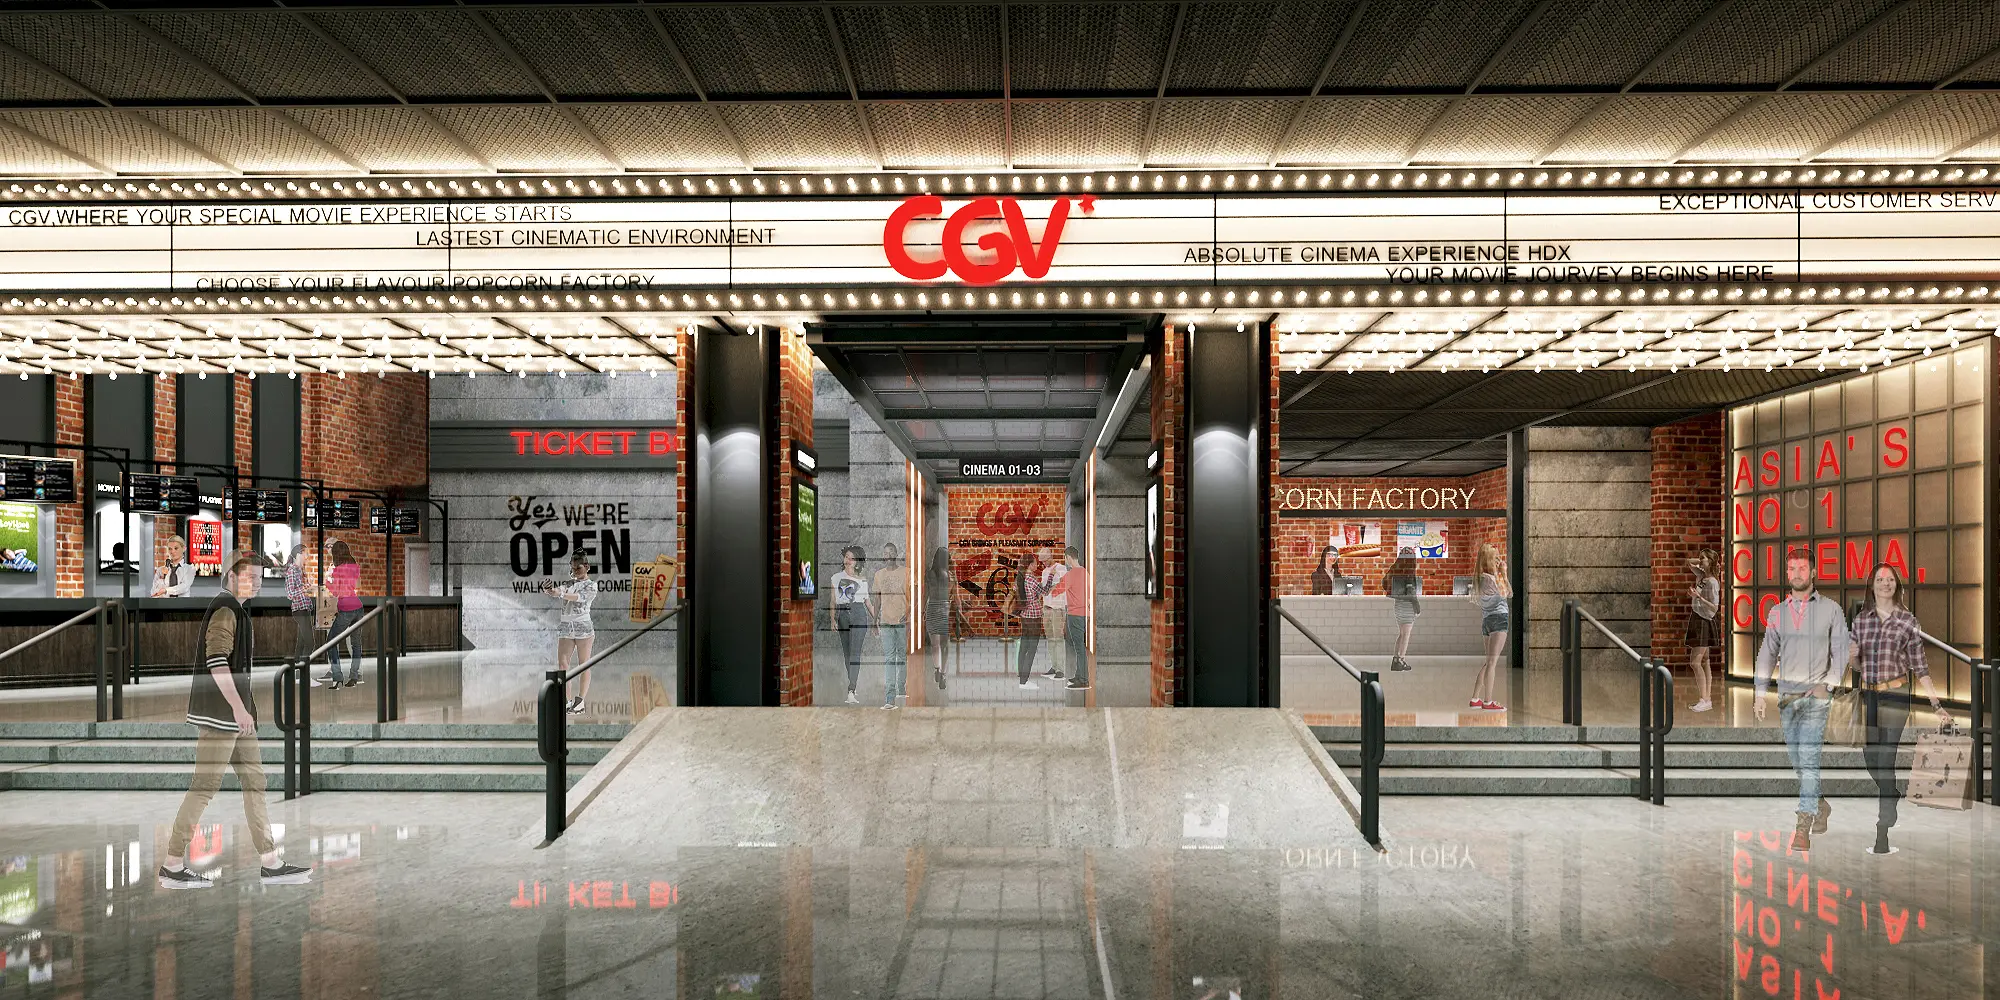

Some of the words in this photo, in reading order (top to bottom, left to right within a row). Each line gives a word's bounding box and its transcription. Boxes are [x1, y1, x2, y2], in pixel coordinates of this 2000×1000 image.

[1660, 192, 1804, 211] EXCEPTIONAL
[1813, 191, 1932, 209] CUSTOMER
[1940, 191, 1997, 208] SERV
[137, 208, 192, 225] YOUR
[200, 207, 283, 225] SPECIAL
[290, 207, 352, 224] MOVIE
[360, 206, 486, 223] EXPERIENCE
[494, 205, 572, 222] STARTS
[416, 229, 503, 246] LASTEST
[511, 228, 621, 246] CINEMATIC
[629, 228, 777, 245] ENVIRONMENT
[884, 195, 1071, 284] CGV
[1183, 246, 1293, 263] ABSOLUTE
[1300, 246, 1380, 262] CINEMA
[1388, 245, 1520, 262] EXPERIENCE
[1528, 244, 1572, 261] HDX
[196, 277, 281, 293] CHOOSE
[289, 277, 345, 293] YOUR
[352, 276, 444, 292] FLAVOUR
[453, 275, 552, 292] POPCORN
[561, 275, 655, 291] FACTORY
[1386, 267, 1445, 284] YOUR
[1452, 266, 1518, 284] MOVIE
[1525, 266, 1624, 283] JOURVEY
[1631, 265, 1709, 282] BEGINS
[1717, 264, 1774, 282] HERE
[510, 431, 637, 456] TICKET
[649, 431, 678, 456] B
[1734, 427, 1909, 490] ASIA'S
[963, 464, 1006, 476] CINEMA
[1008, 464, 1041, 476] 01-03
[1353, 487, 1476, 510] FACTORY
[507, 495, 560, 531] Yes
[563, 502, 630, 527] WE'RE
[976, 502, 1040, 537] CGV
[509, 528, 631, 577] OPEN
